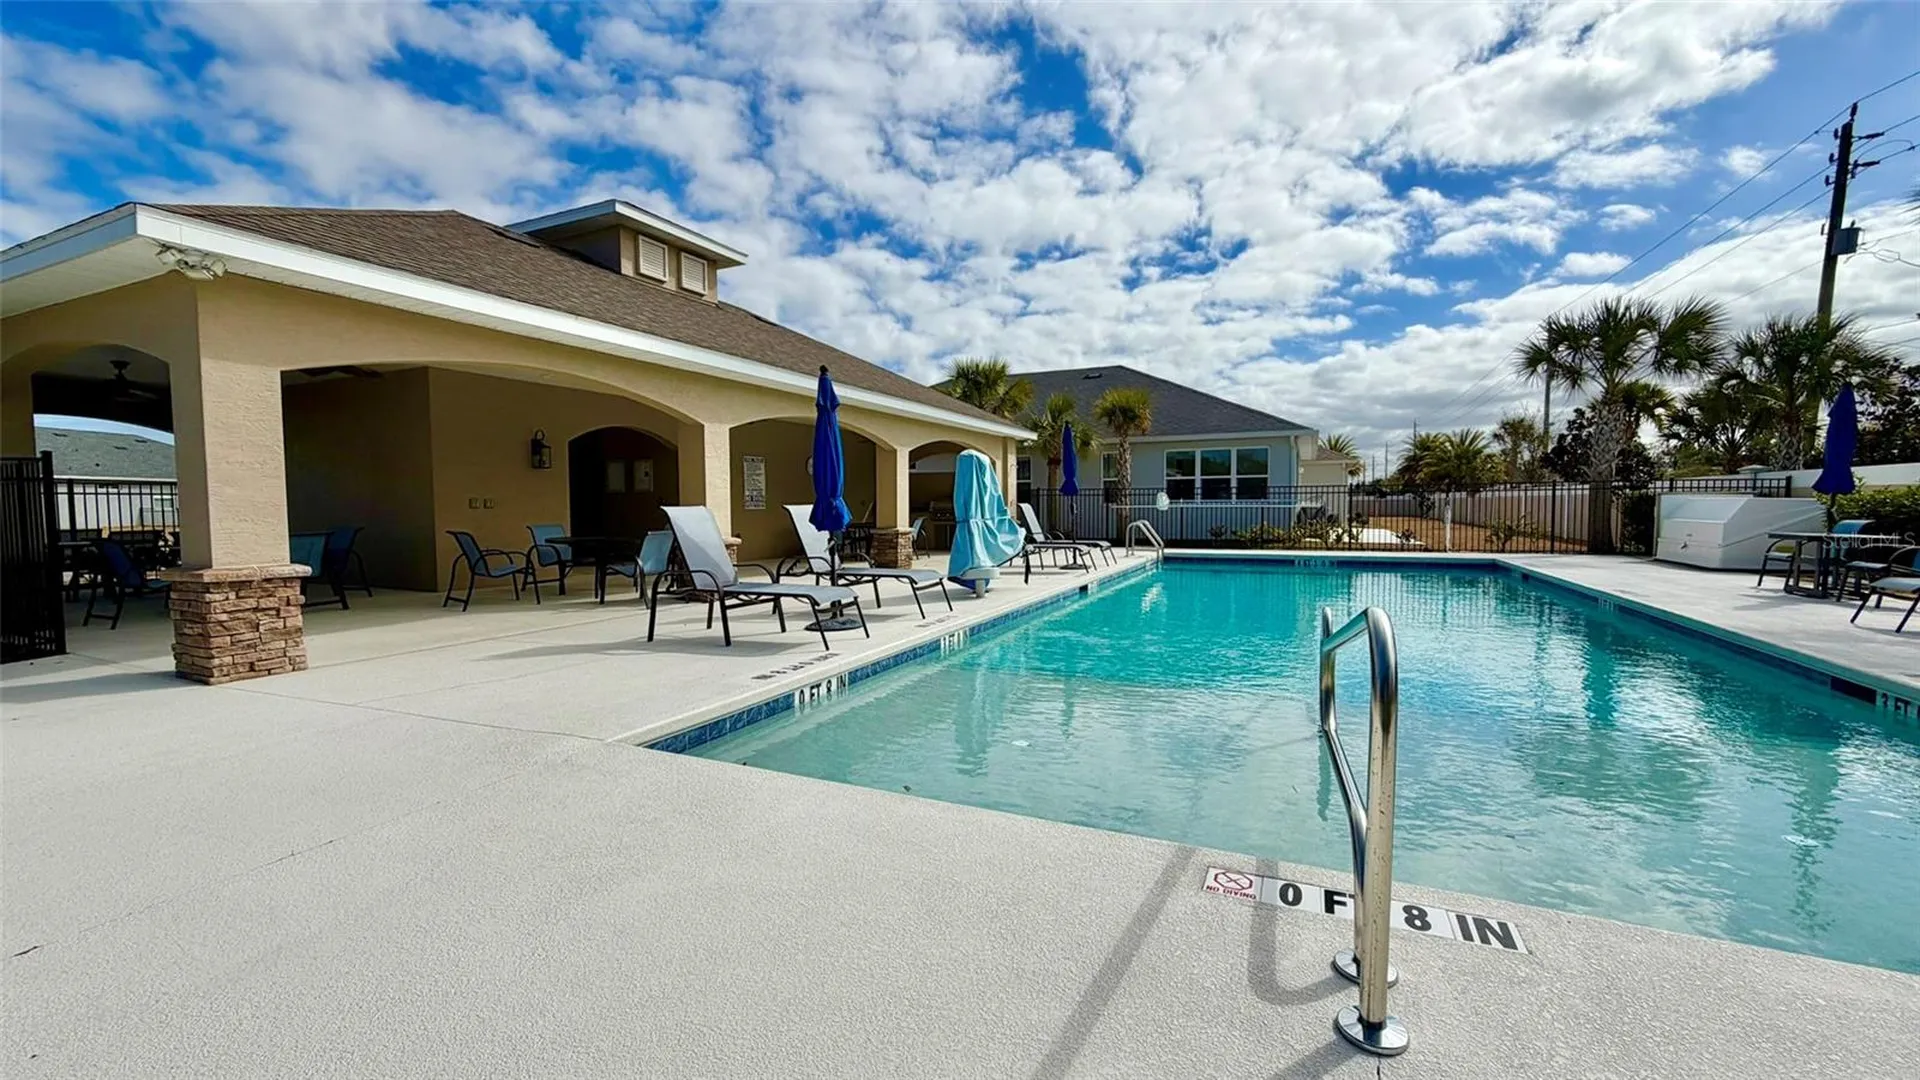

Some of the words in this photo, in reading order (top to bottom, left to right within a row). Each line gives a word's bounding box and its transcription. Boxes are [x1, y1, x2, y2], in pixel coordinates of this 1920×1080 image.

[810, 683, 821, 701] FT
[836, 673, 846, 690] IN
[1895, 696, 1911, 717] FT
[1206, 885, 1220, 893] NO
[1223, 889, 1257, 900] DIVING
[1279, 883, 1303, 907] 0
[1324, 890, 1355, 915] F
[1402, 905, 1432, 932] 8
[1455, 914, 1518, 950] IN
